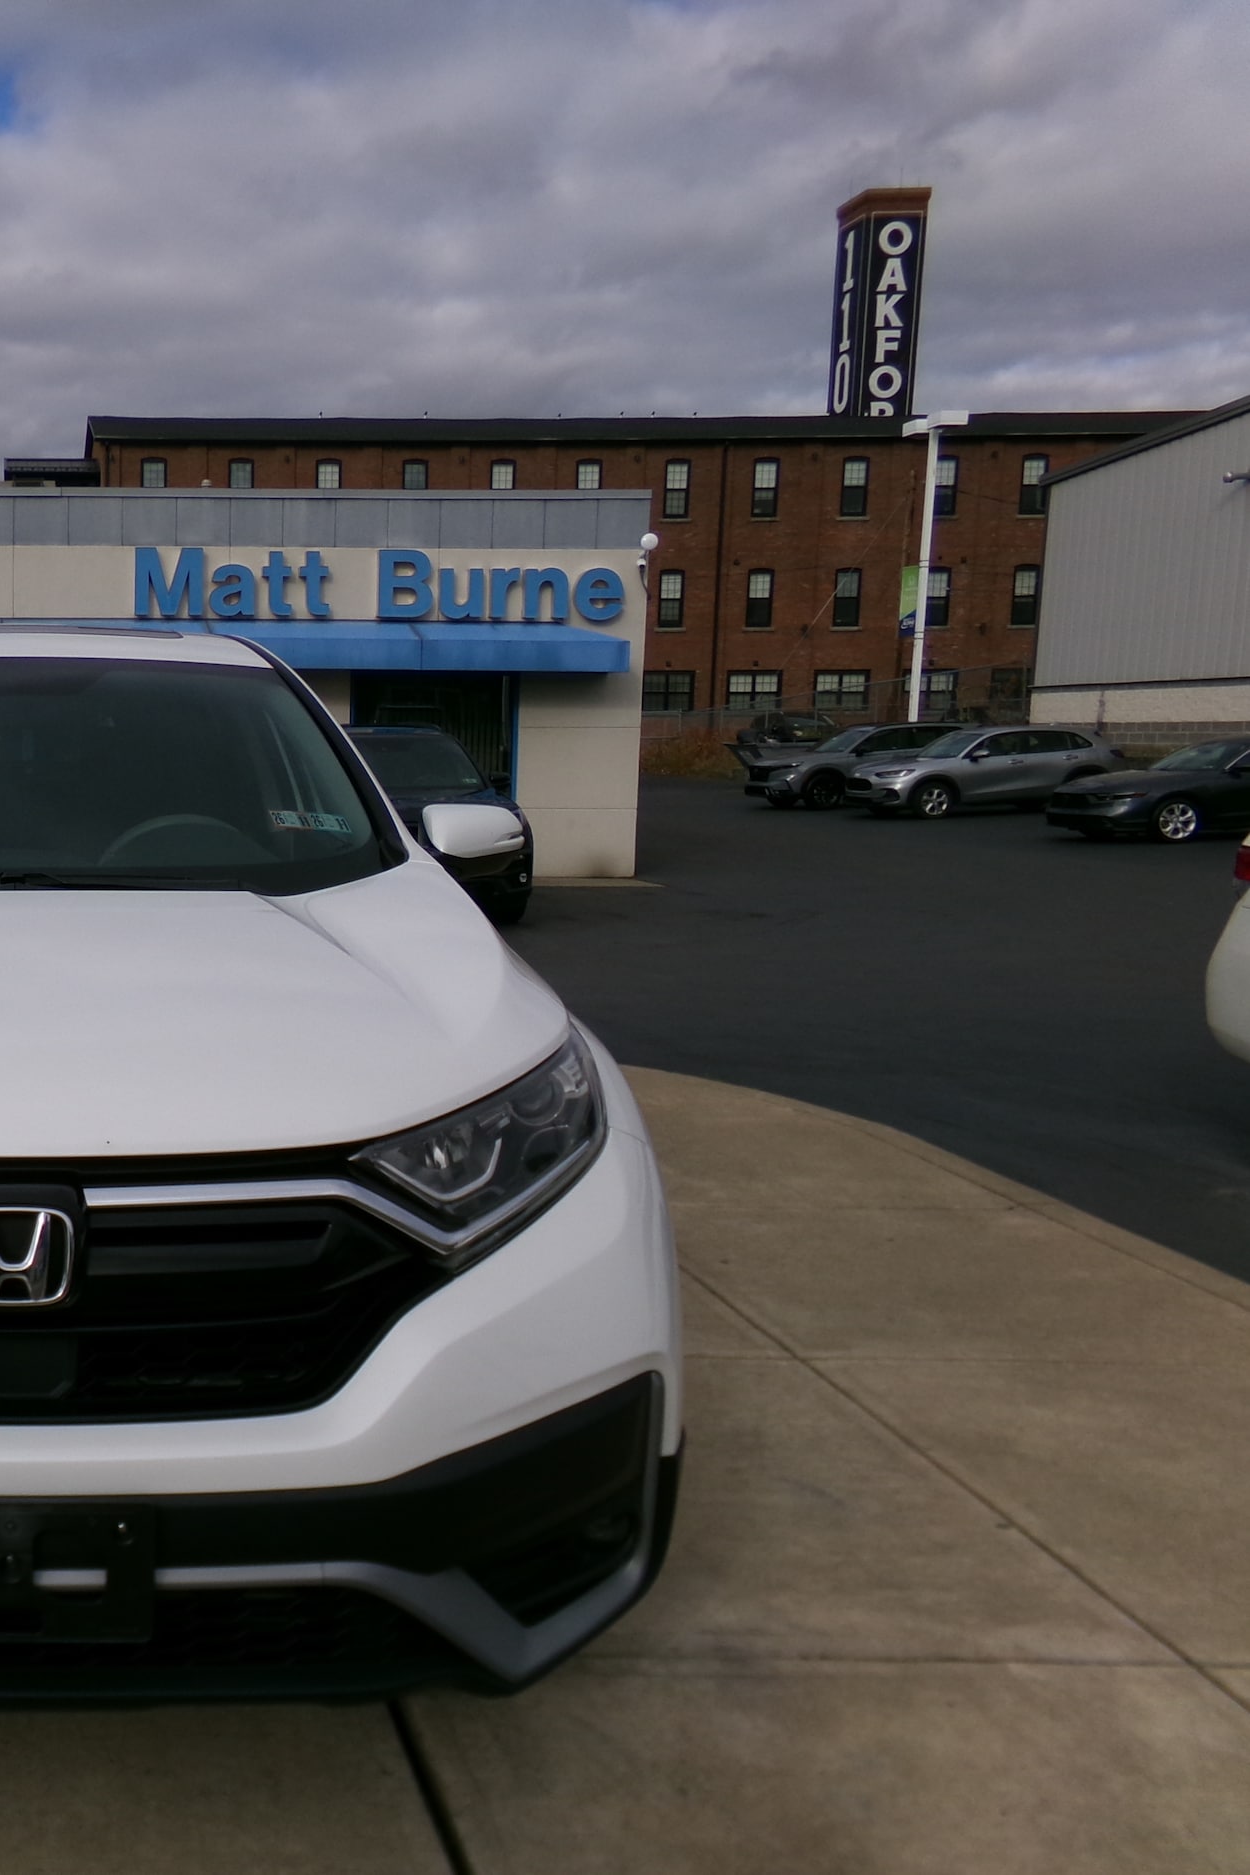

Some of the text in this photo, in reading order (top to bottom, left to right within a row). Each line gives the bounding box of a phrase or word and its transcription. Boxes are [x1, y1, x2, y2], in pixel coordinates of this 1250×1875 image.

[833, 230, 855, 414] 110
[134, 547, 625, 622] Matt Burne
